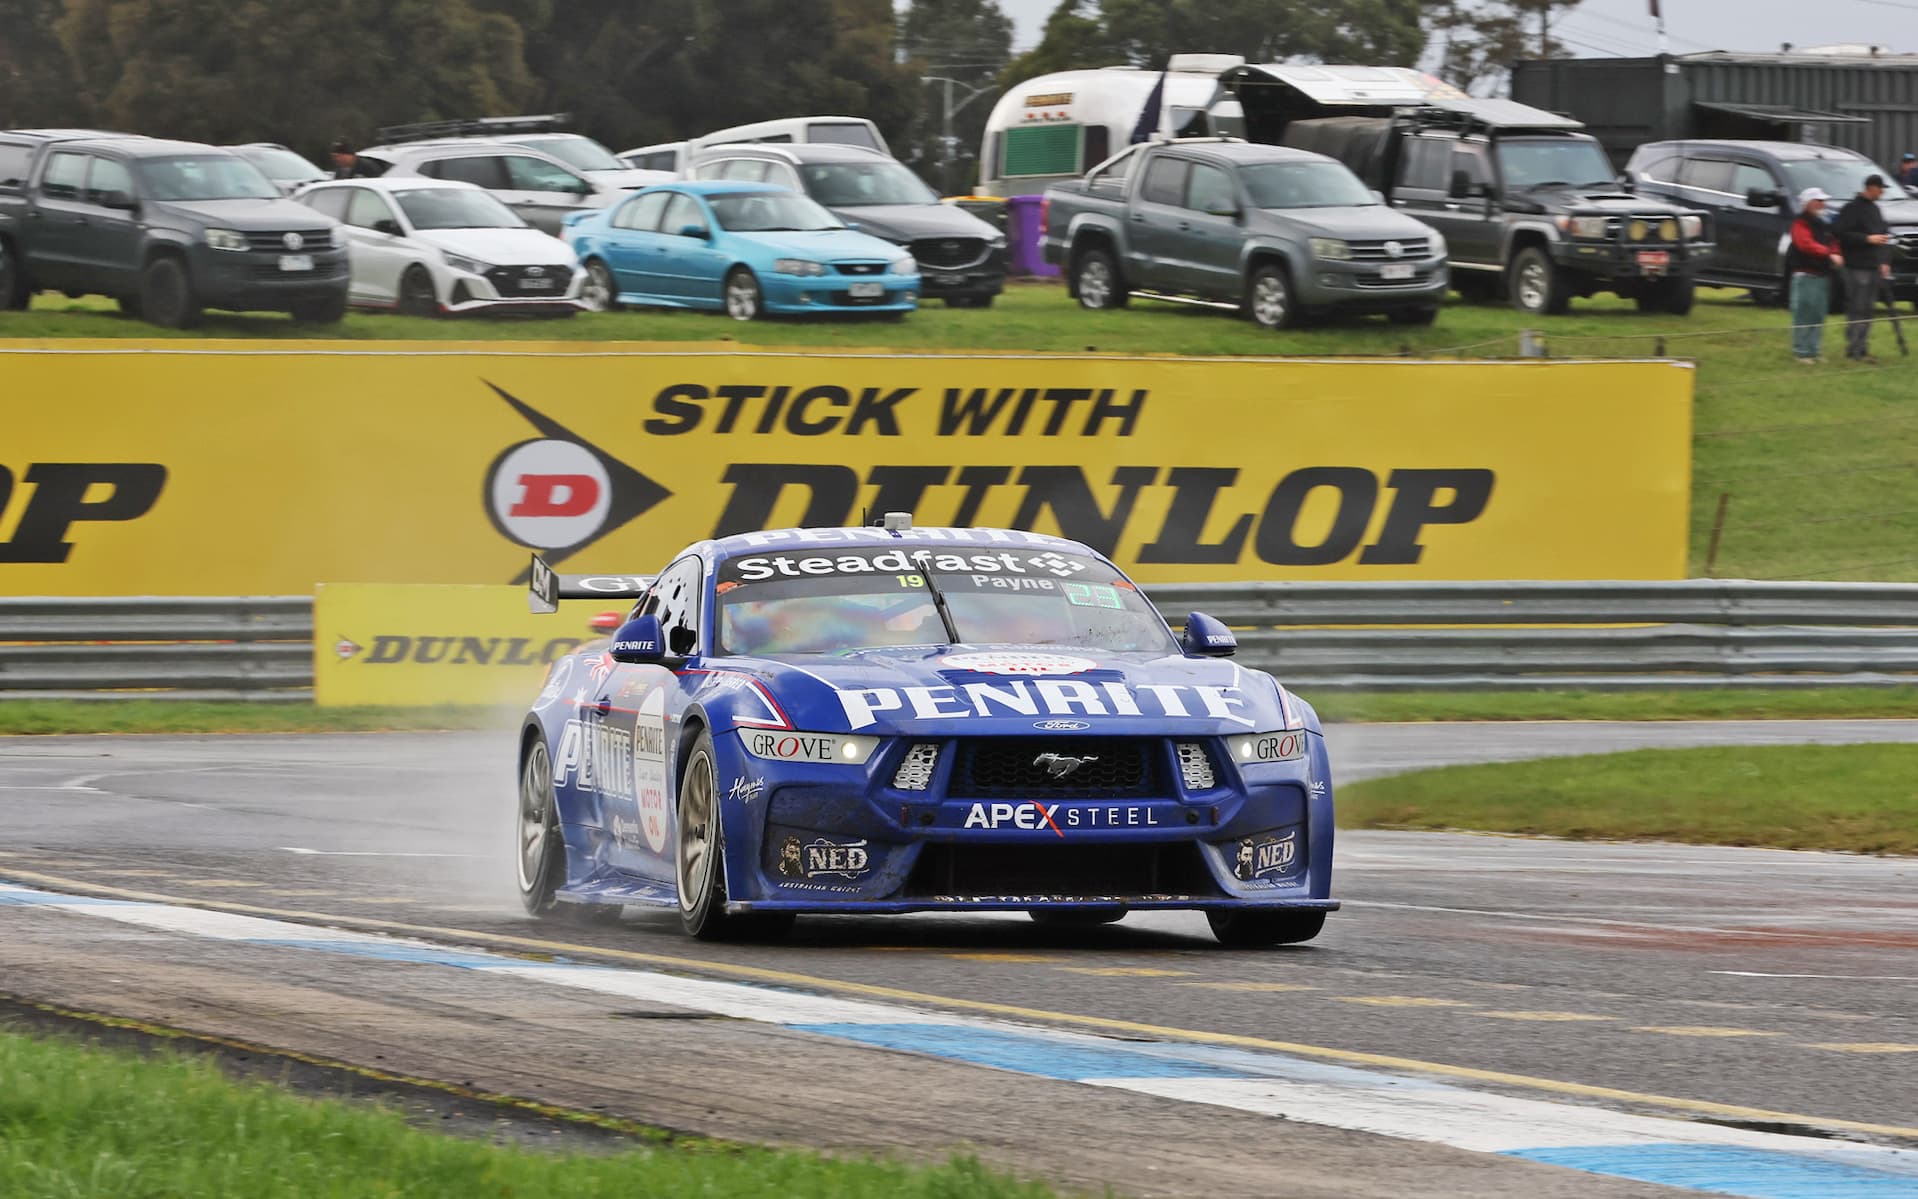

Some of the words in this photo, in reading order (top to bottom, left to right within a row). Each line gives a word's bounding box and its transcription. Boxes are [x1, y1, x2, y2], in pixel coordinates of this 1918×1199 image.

[643, 384, 919, 436] STICK
[936, 388, 1148, 436] WITH
[508, 474, 599, 517] D
[708, 463, 1495, 566] DUNLOP
[737, 550, 1025, 580] Steadfast
[896, 575, 924, 588] 19
[971, 574, 1054, 590] Payne
[614, 640, 655, 650] PENRITE
[835, 680, 1256, 731] PENRITE
[1043, 720, 1081, 730] Ford
[964, 800, 1064, 838] APEX
[1067, 807, 1159, 826] STEEL
[809, 847, 869, 870] NED
[1258, 841, 1296, 869] NED
